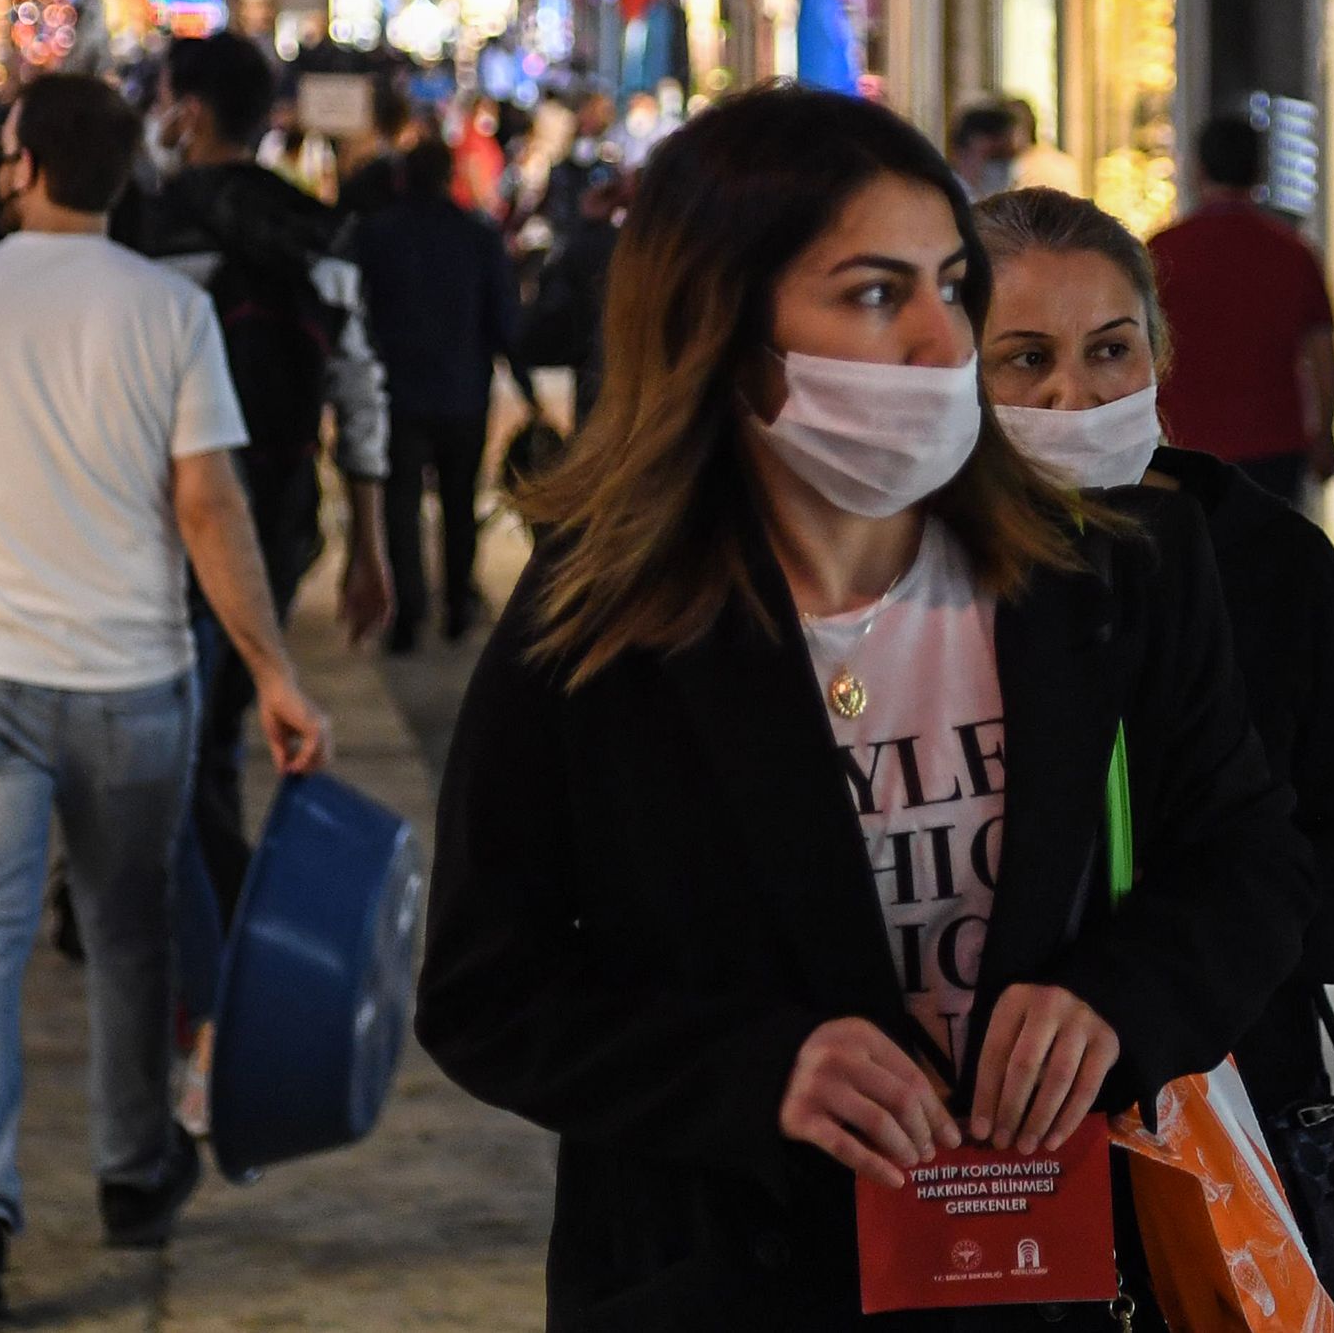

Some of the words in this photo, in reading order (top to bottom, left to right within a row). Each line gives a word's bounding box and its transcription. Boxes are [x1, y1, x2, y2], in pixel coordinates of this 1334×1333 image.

[909, 1165, 939, 1182] YENİ
[941, 1165, 957, 1180] TİP
[961, 1159, 1060, 1178] KORONAVİRÜS
[917, 1182, 988, 1199] HAKKINDA
[991, 1177, 1054, 1194] BİLİNMESİ
[945, 1198, 1027, 1214] GEREKENLER
